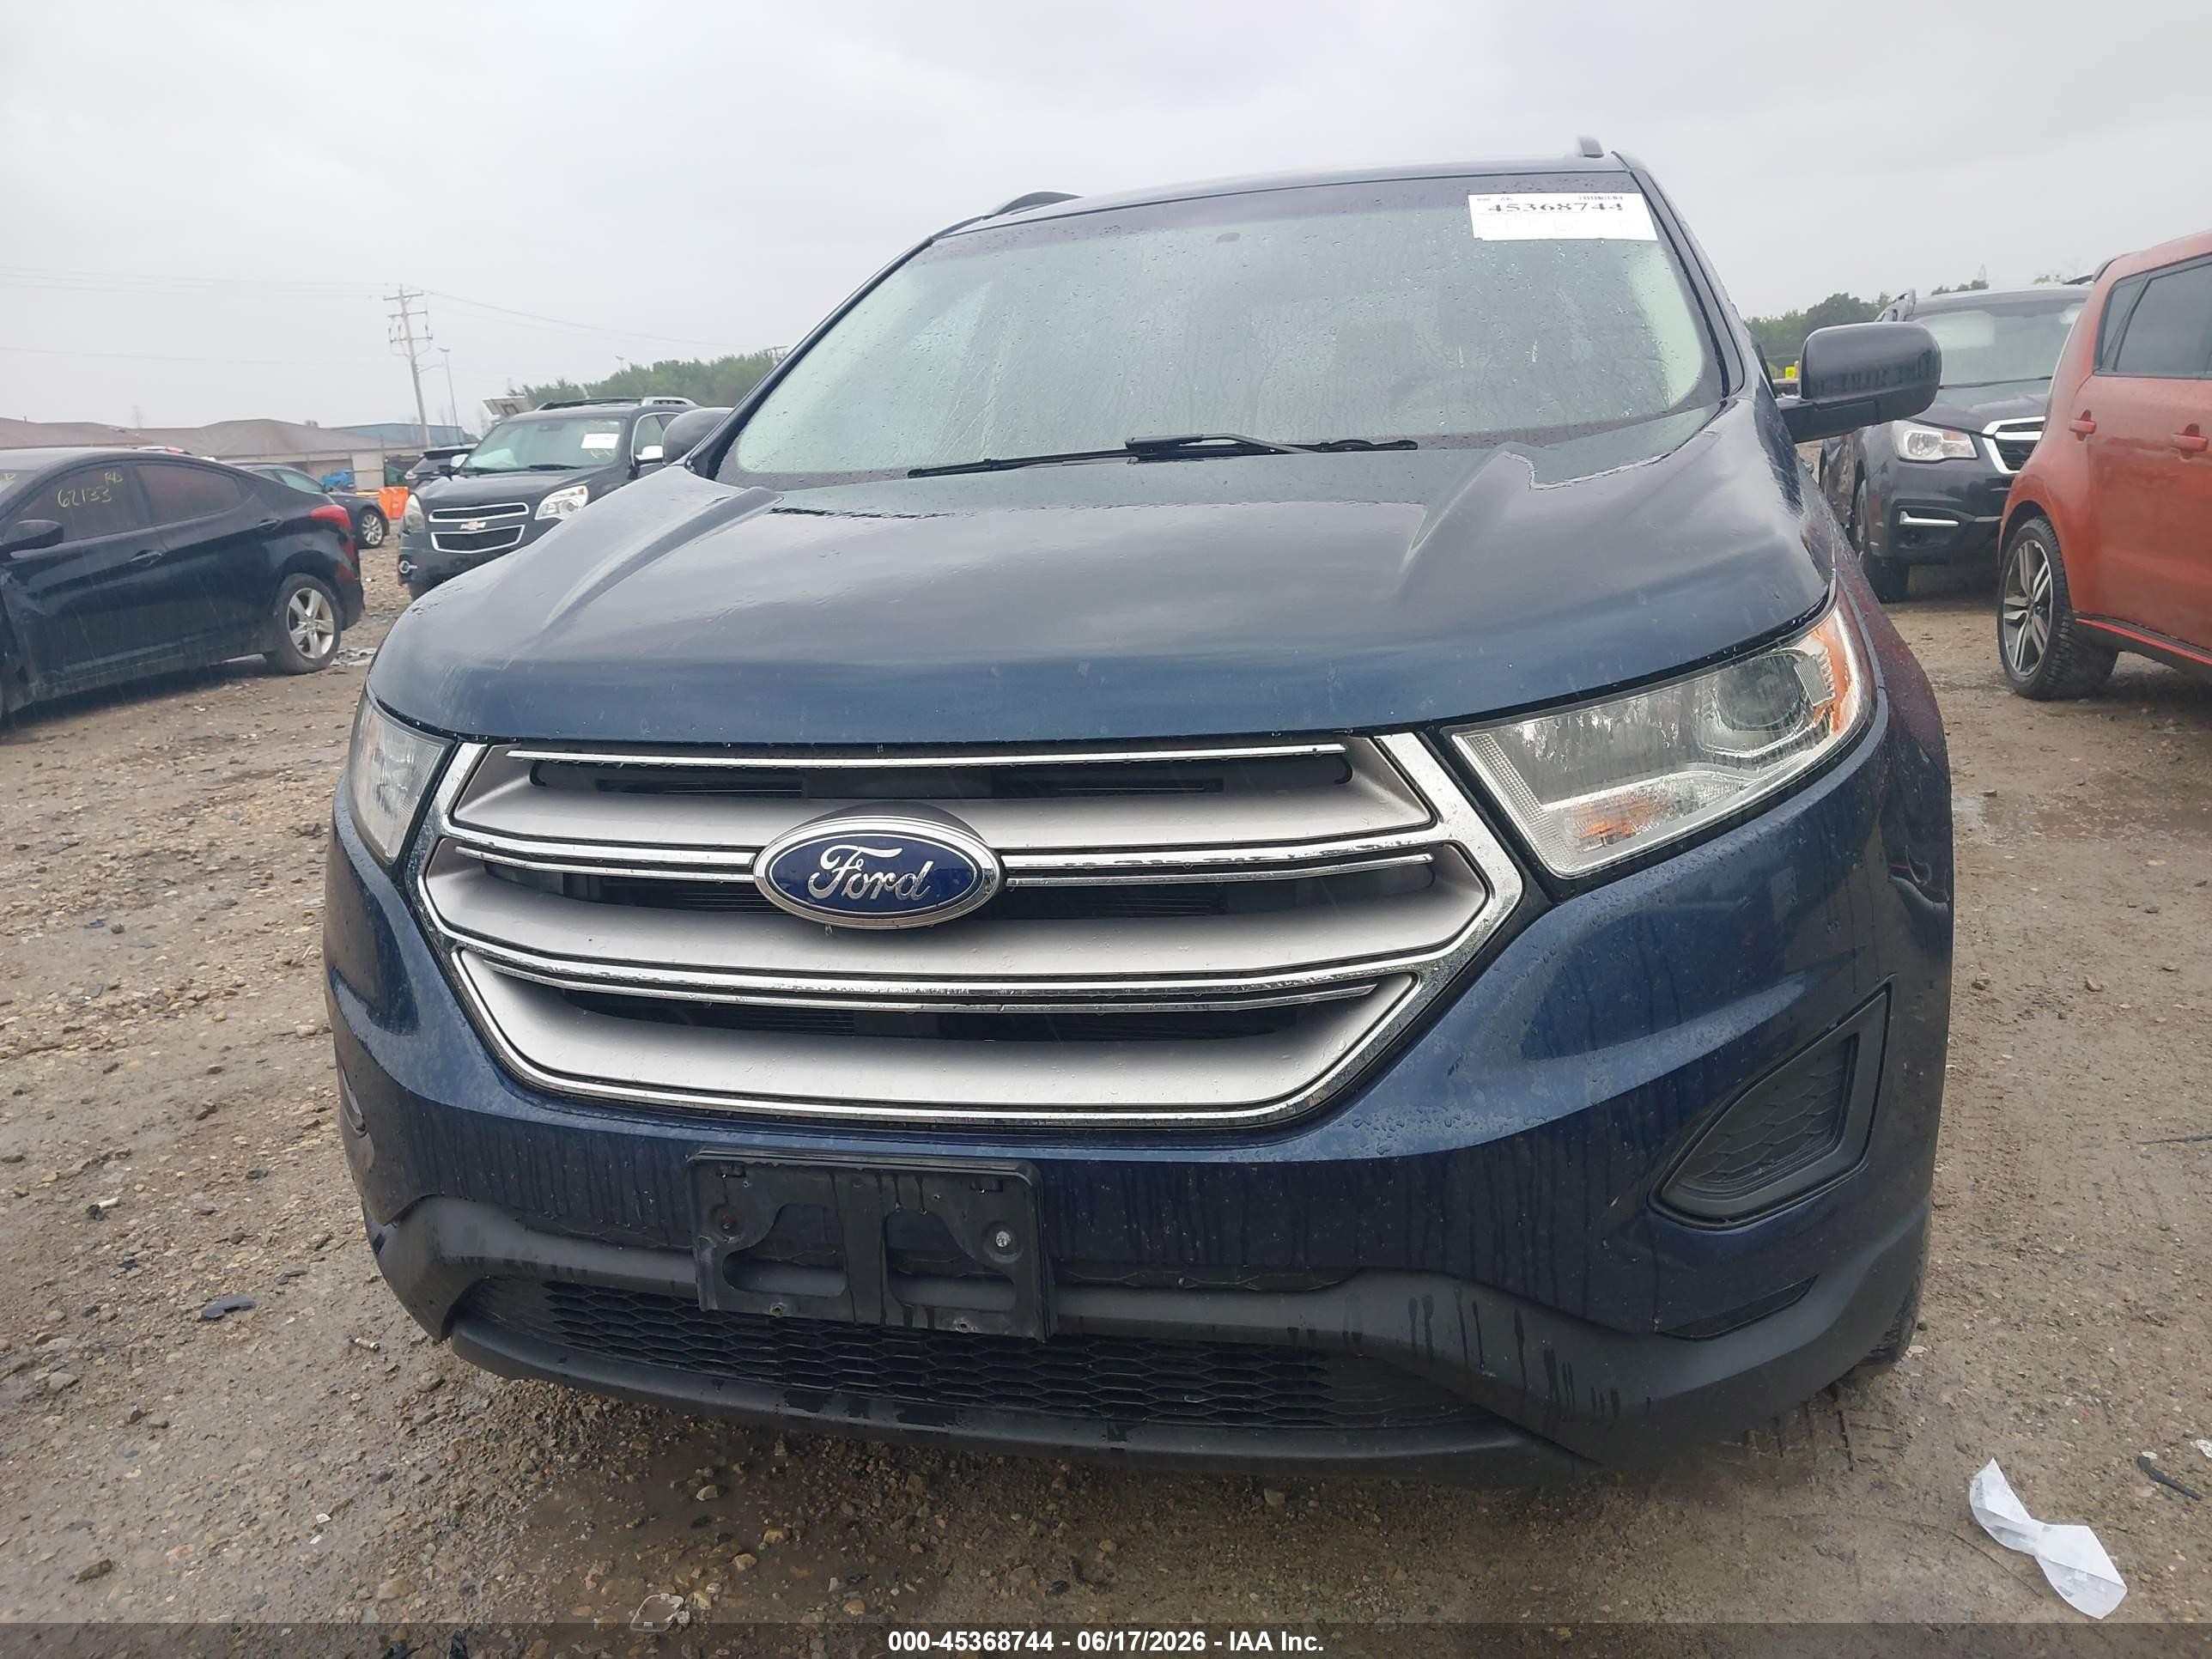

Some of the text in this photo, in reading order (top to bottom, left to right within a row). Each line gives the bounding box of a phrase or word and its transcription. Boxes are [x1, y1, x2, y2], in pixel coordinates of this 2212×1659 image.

[1487, 202, 1624, 212] 45368744
[58, 486, 112, 508] 62133
[807, 844, 934, 901] Ford
